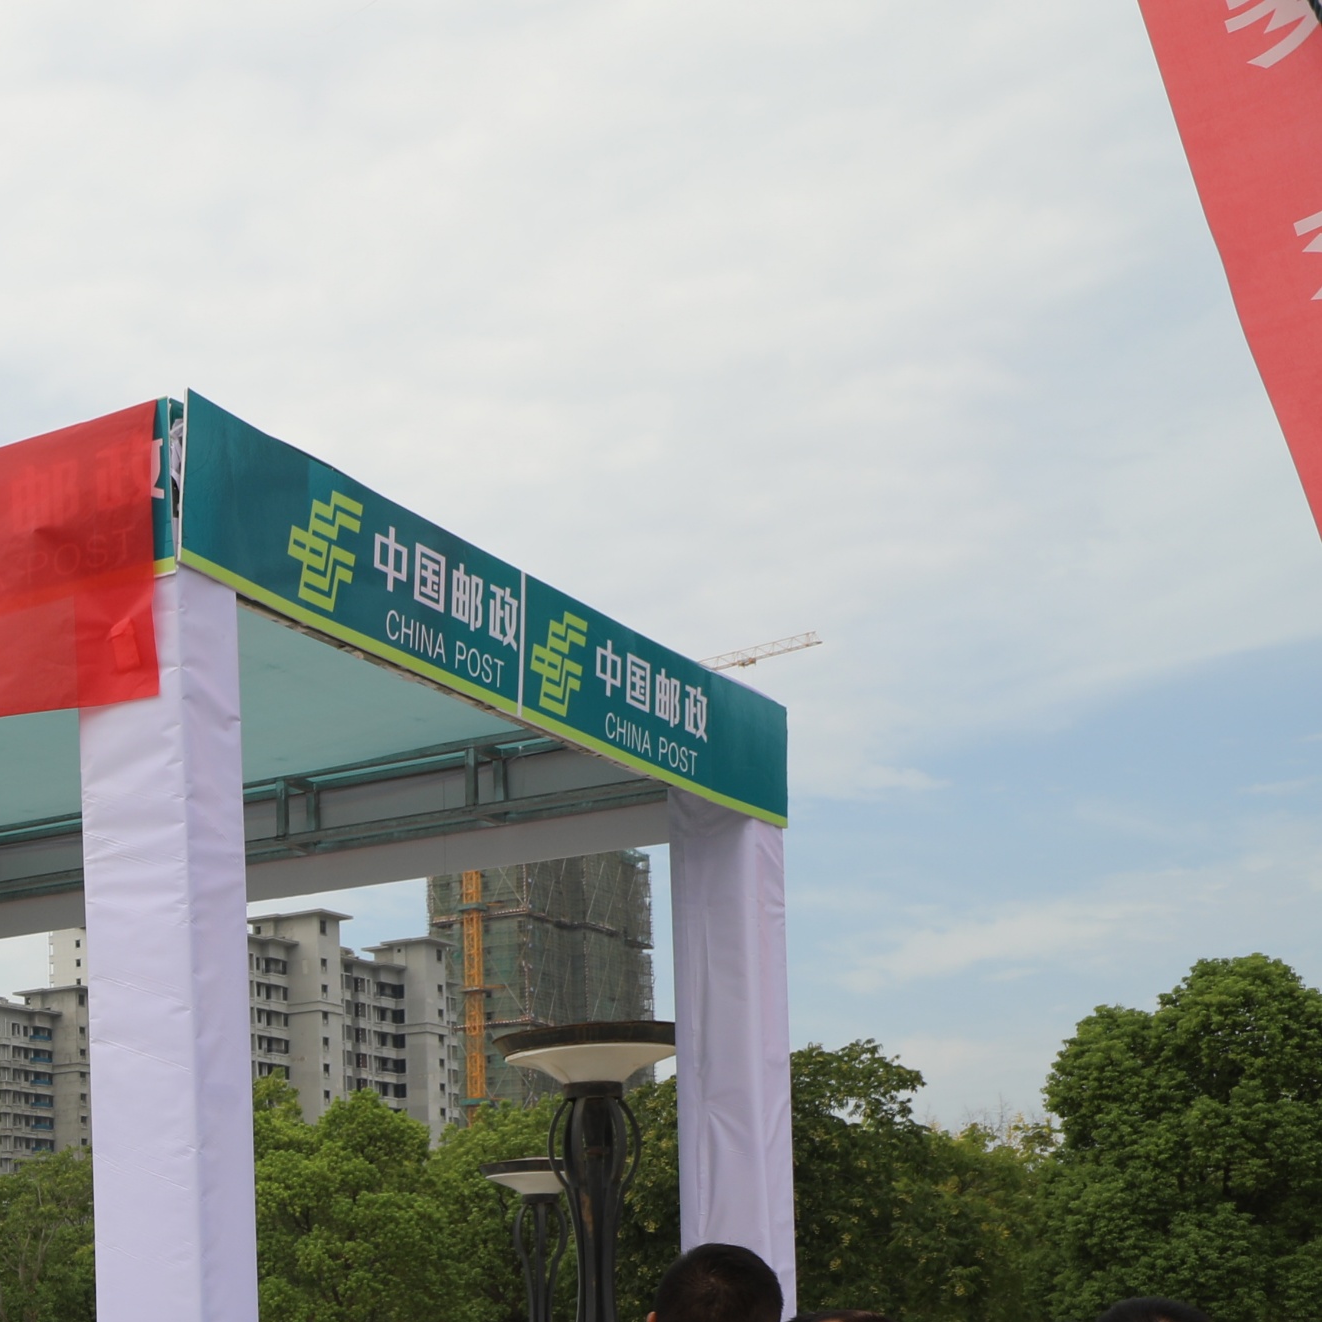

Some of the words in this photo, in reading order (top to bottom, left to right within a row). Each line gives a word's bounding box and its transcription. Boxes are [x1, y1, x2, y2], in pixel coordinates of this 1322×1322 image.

[374, 525, 519, 653] 中国邮政
[386, 609, 446, 663] CHINA
[455, 640, 505, 689] POST
[595, 638, 708, 743] 中国邮政
[605, 711, 652, 759] CHINA
[659, 739, 698, 776] POST
